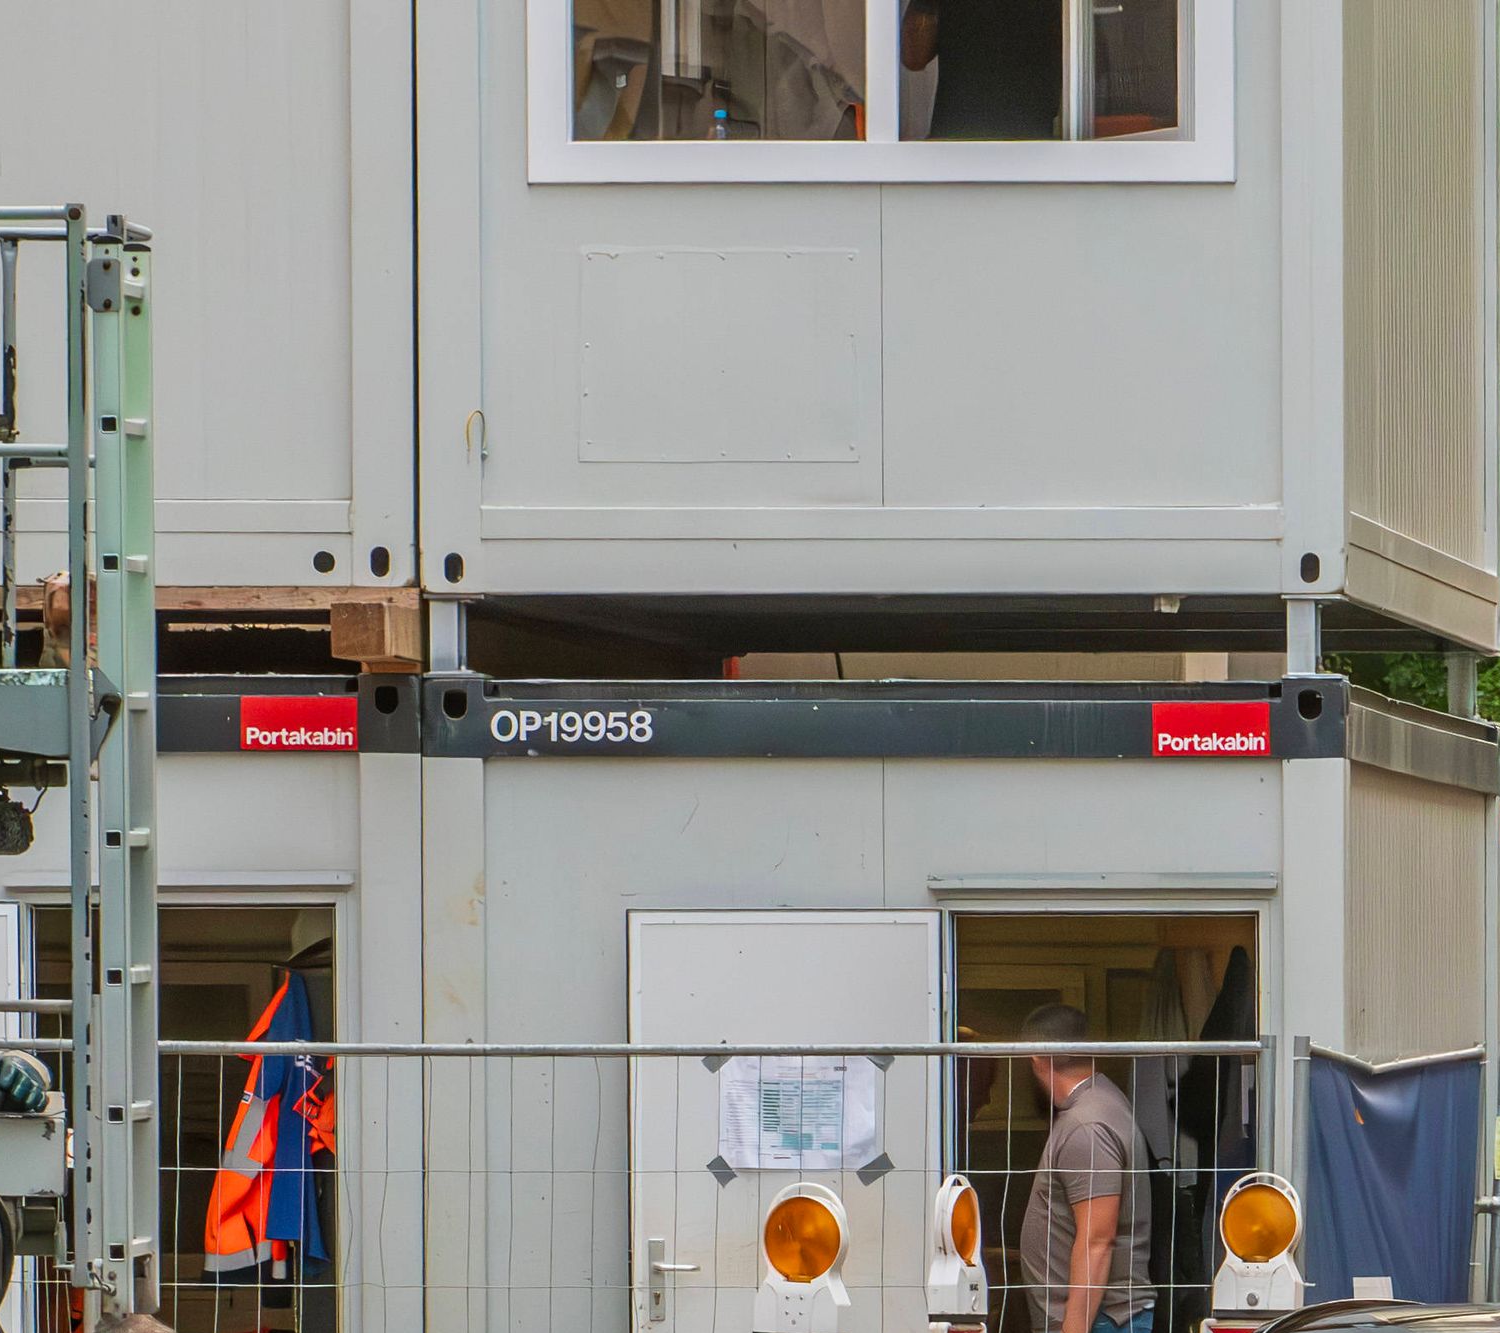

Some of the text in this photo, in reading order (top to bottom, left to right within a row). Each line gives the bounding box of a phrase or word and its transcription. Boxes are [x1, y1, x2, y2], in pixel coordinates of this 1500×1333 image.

[490, 710, 654, 742] OP19958
[246, 727, 354, 746] Portakabin
[1158, 732, 1266, 751] Portakabin
